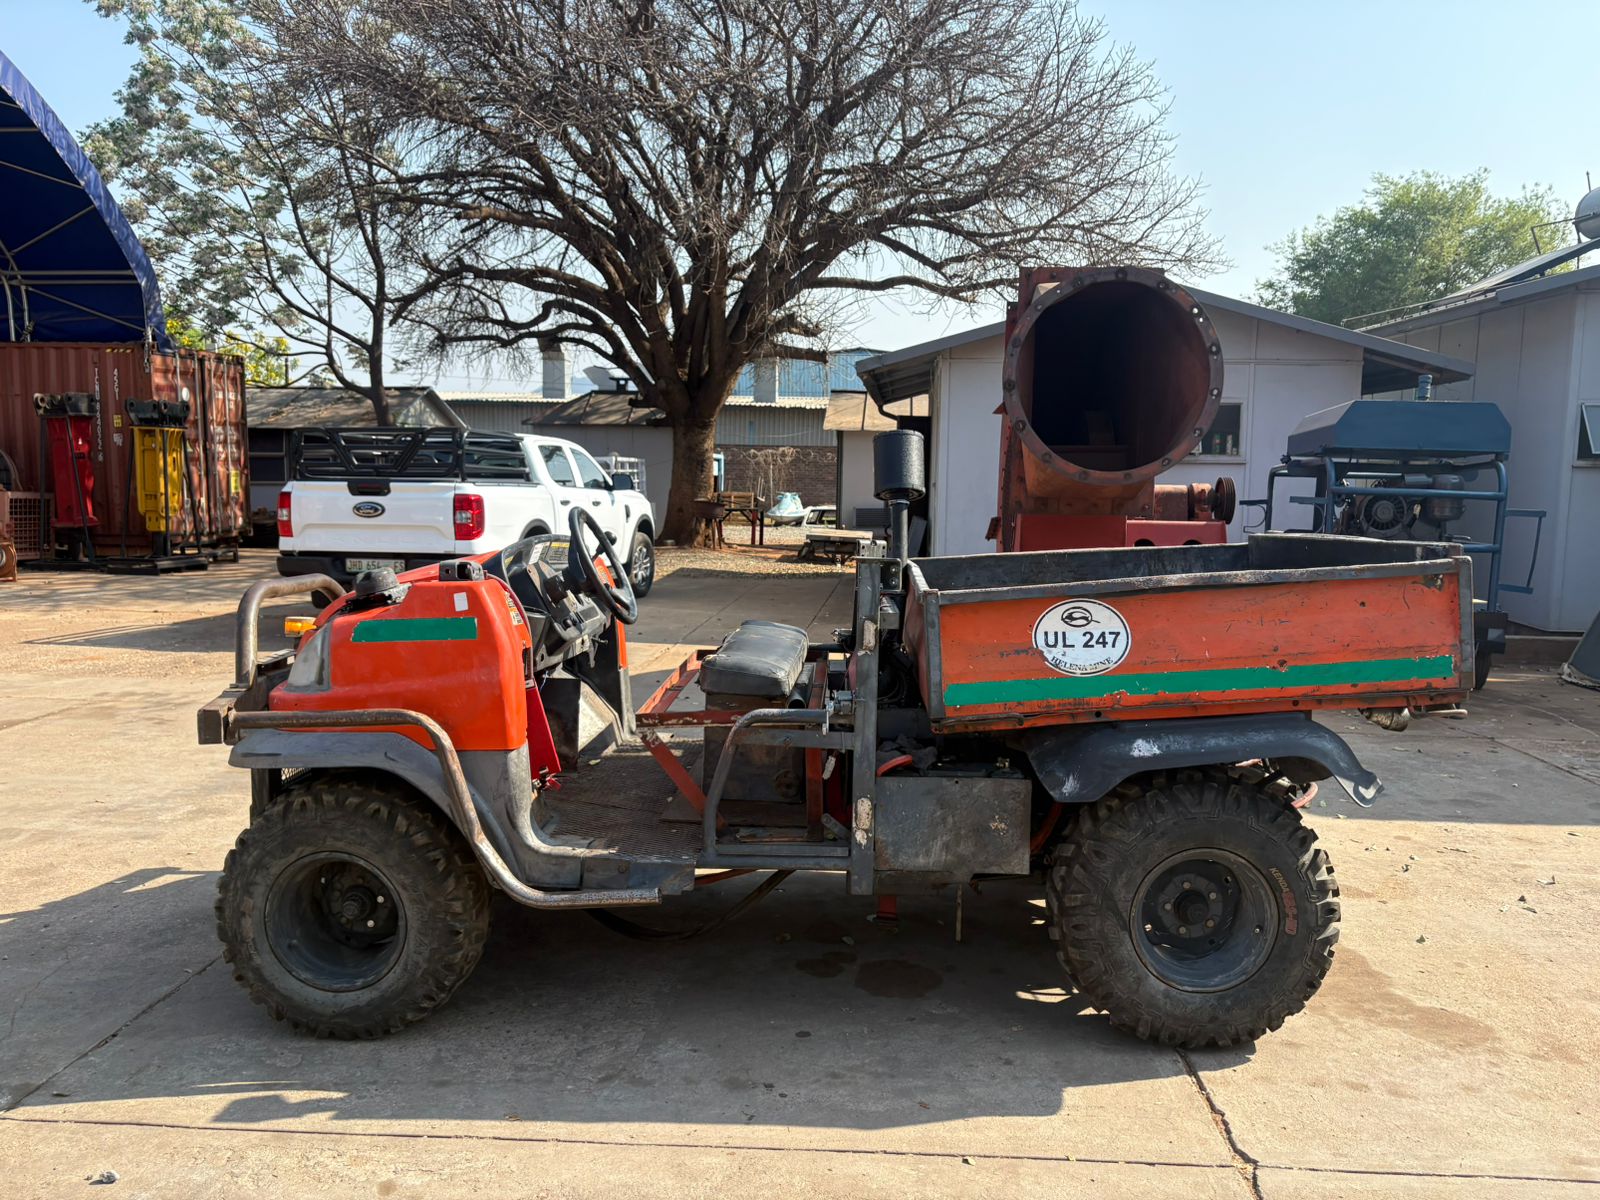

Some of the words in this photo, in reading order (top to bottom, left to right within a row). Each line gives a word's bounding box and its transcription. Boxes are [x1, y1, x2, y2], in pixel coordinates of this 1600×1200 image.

[1044, 631, 1075, 648] UL
[1082, 631, 1120, 648] 247
[1269, 867, 1289, 892] KENDA
